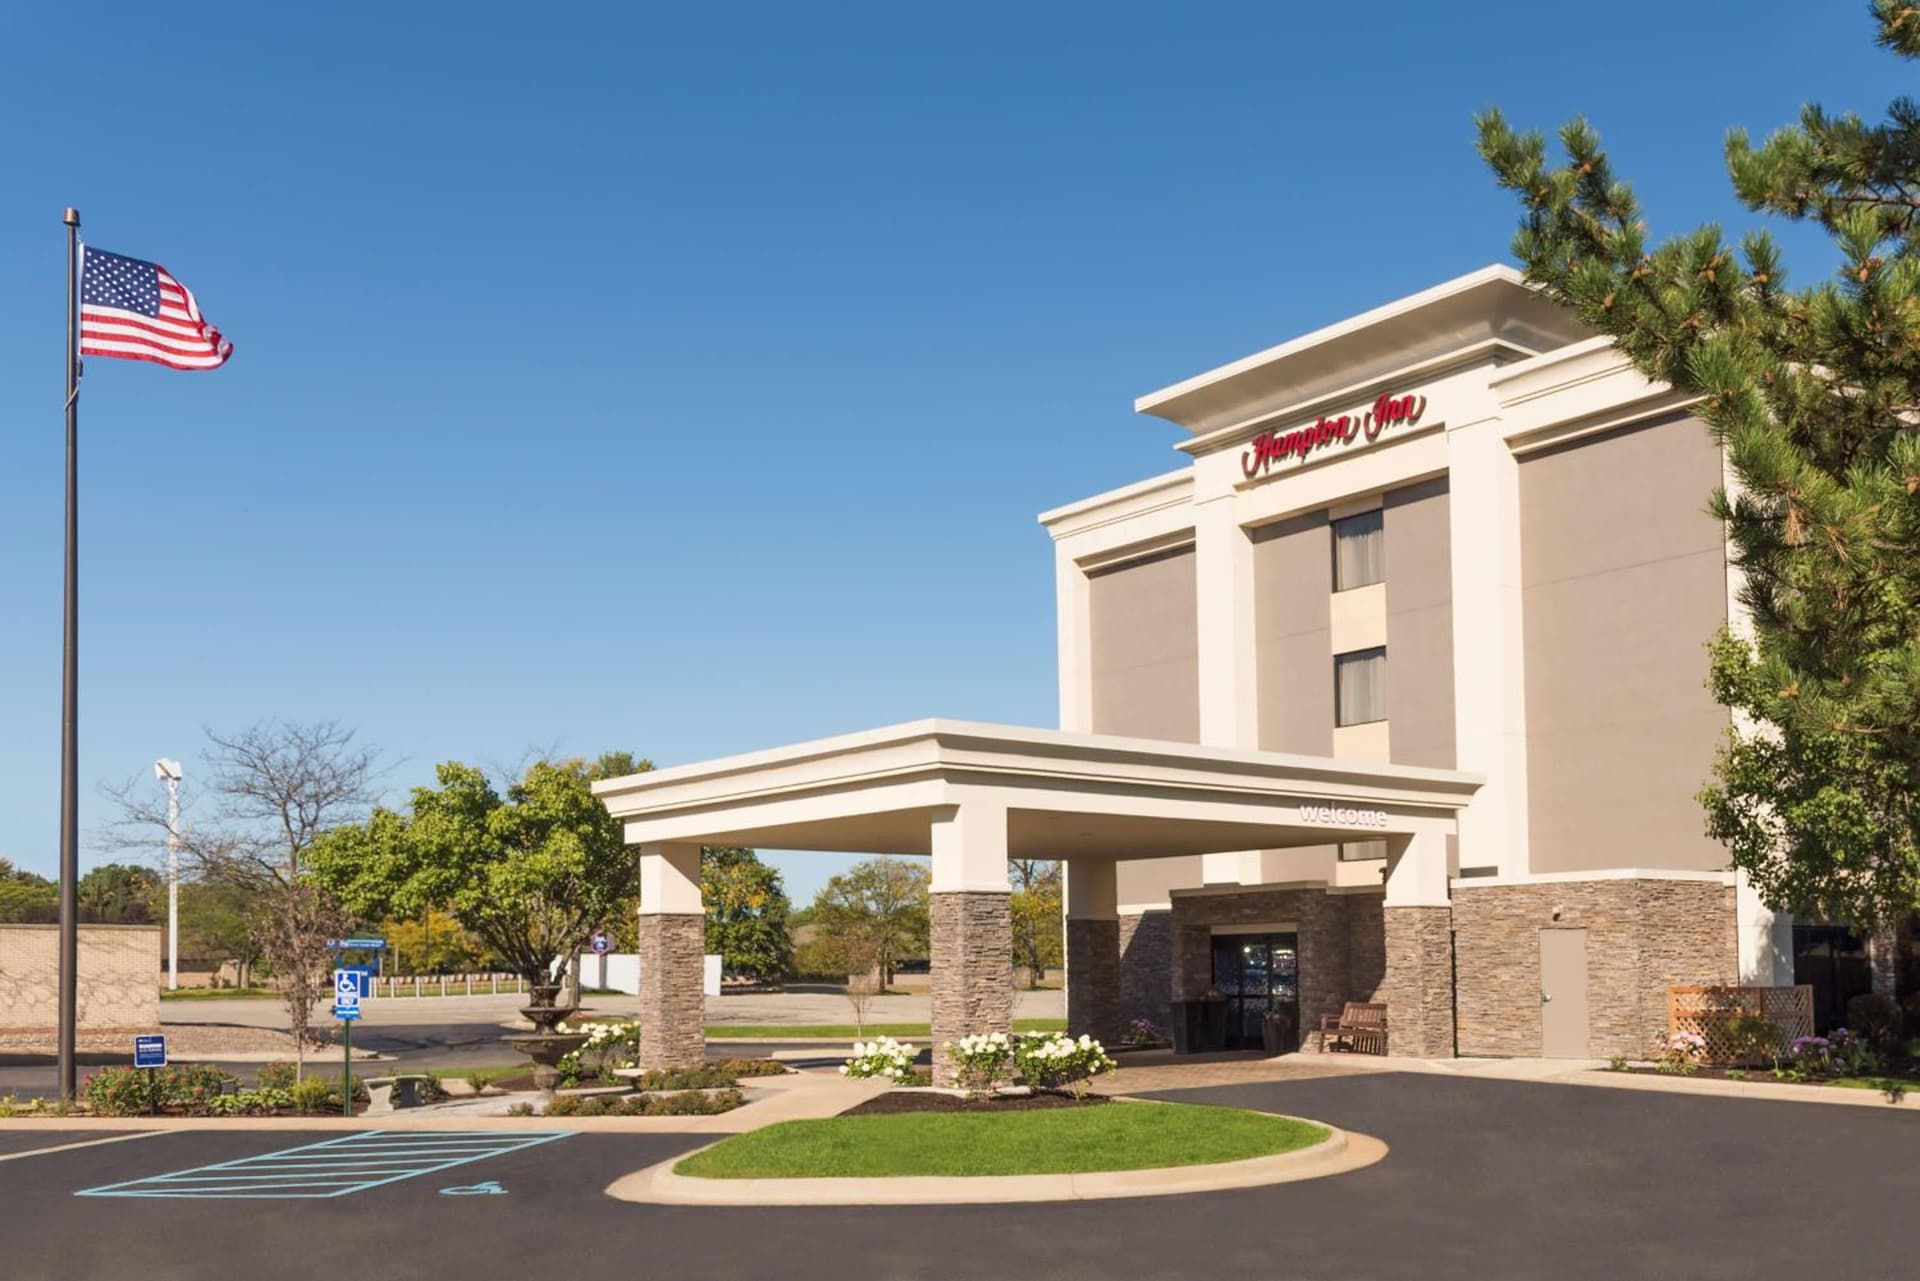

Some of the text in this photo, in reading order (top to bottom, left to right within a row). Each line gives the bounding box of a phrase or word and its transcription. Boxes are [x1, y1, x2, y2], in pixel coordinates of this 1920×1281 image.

[1241, 392, 1427, 479] Hampton Inn
[1300, 801, 1387, 826] welcome
